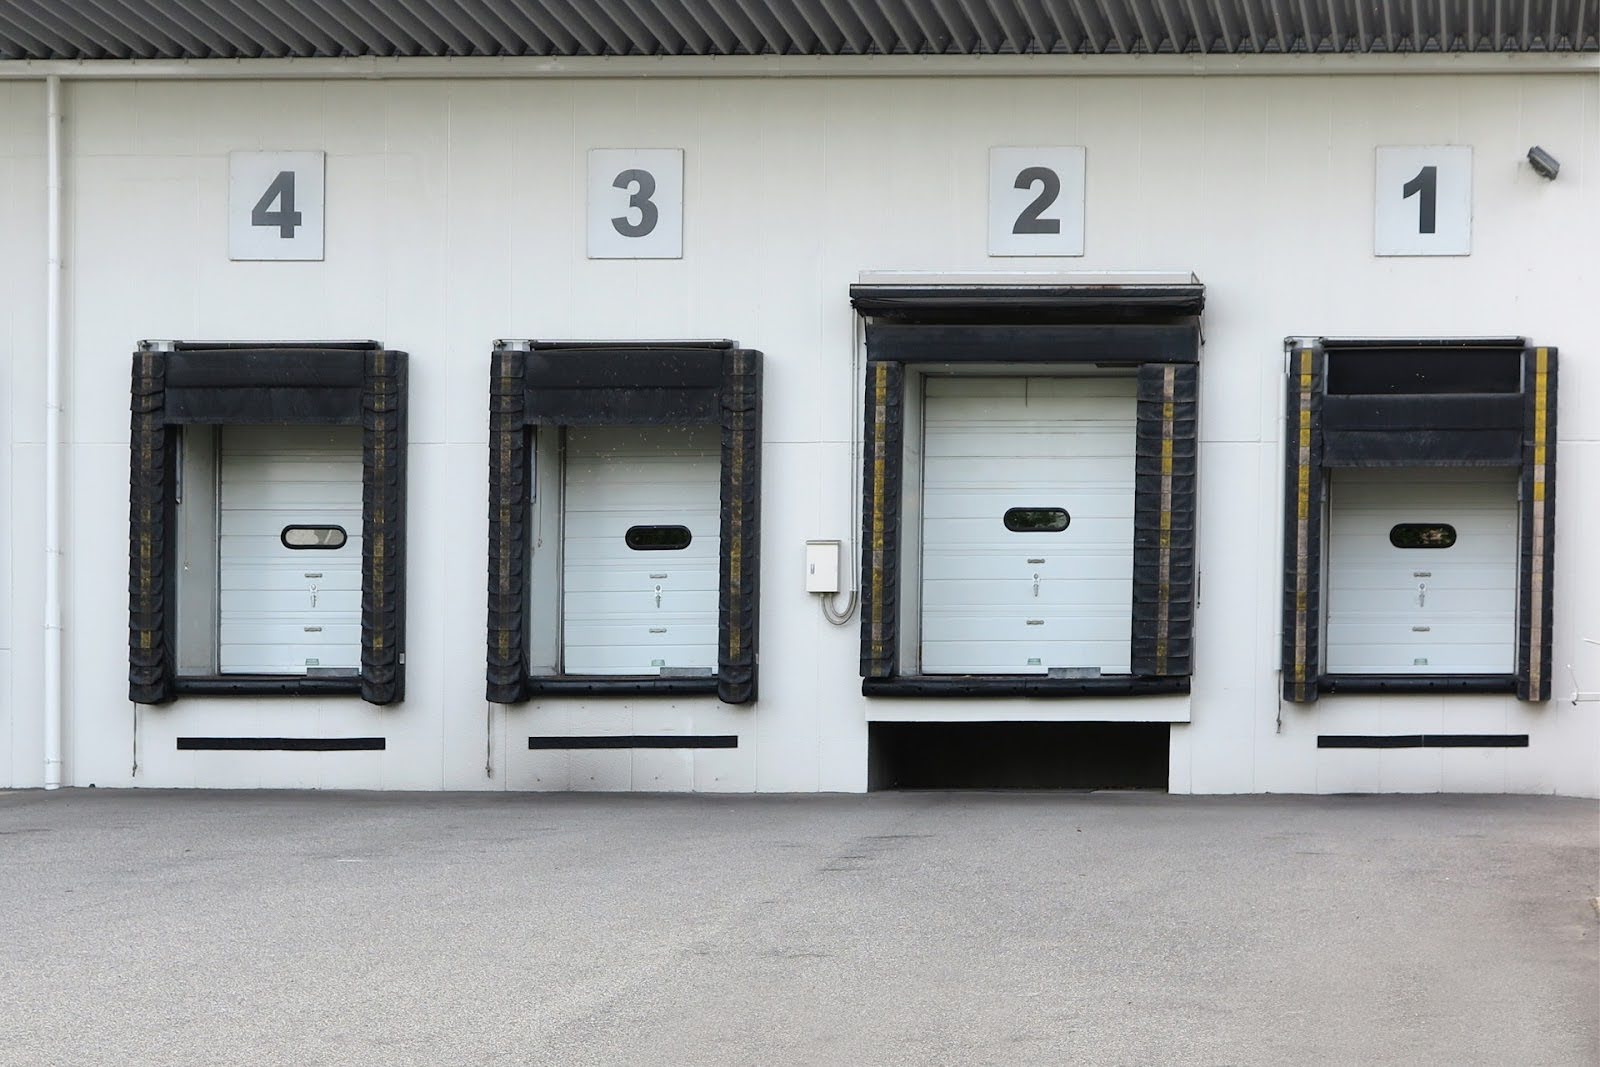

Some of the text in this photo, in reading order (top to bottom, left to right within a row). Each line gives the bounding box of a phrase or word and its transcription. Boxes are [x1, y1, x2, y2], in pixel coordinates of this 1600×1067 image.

[251, 171, 302, 239] 4
[611, 169, 659, 238] 3
[1012, 167, 1061, 235] 2
[1402, 166, 1438, 234] 1
